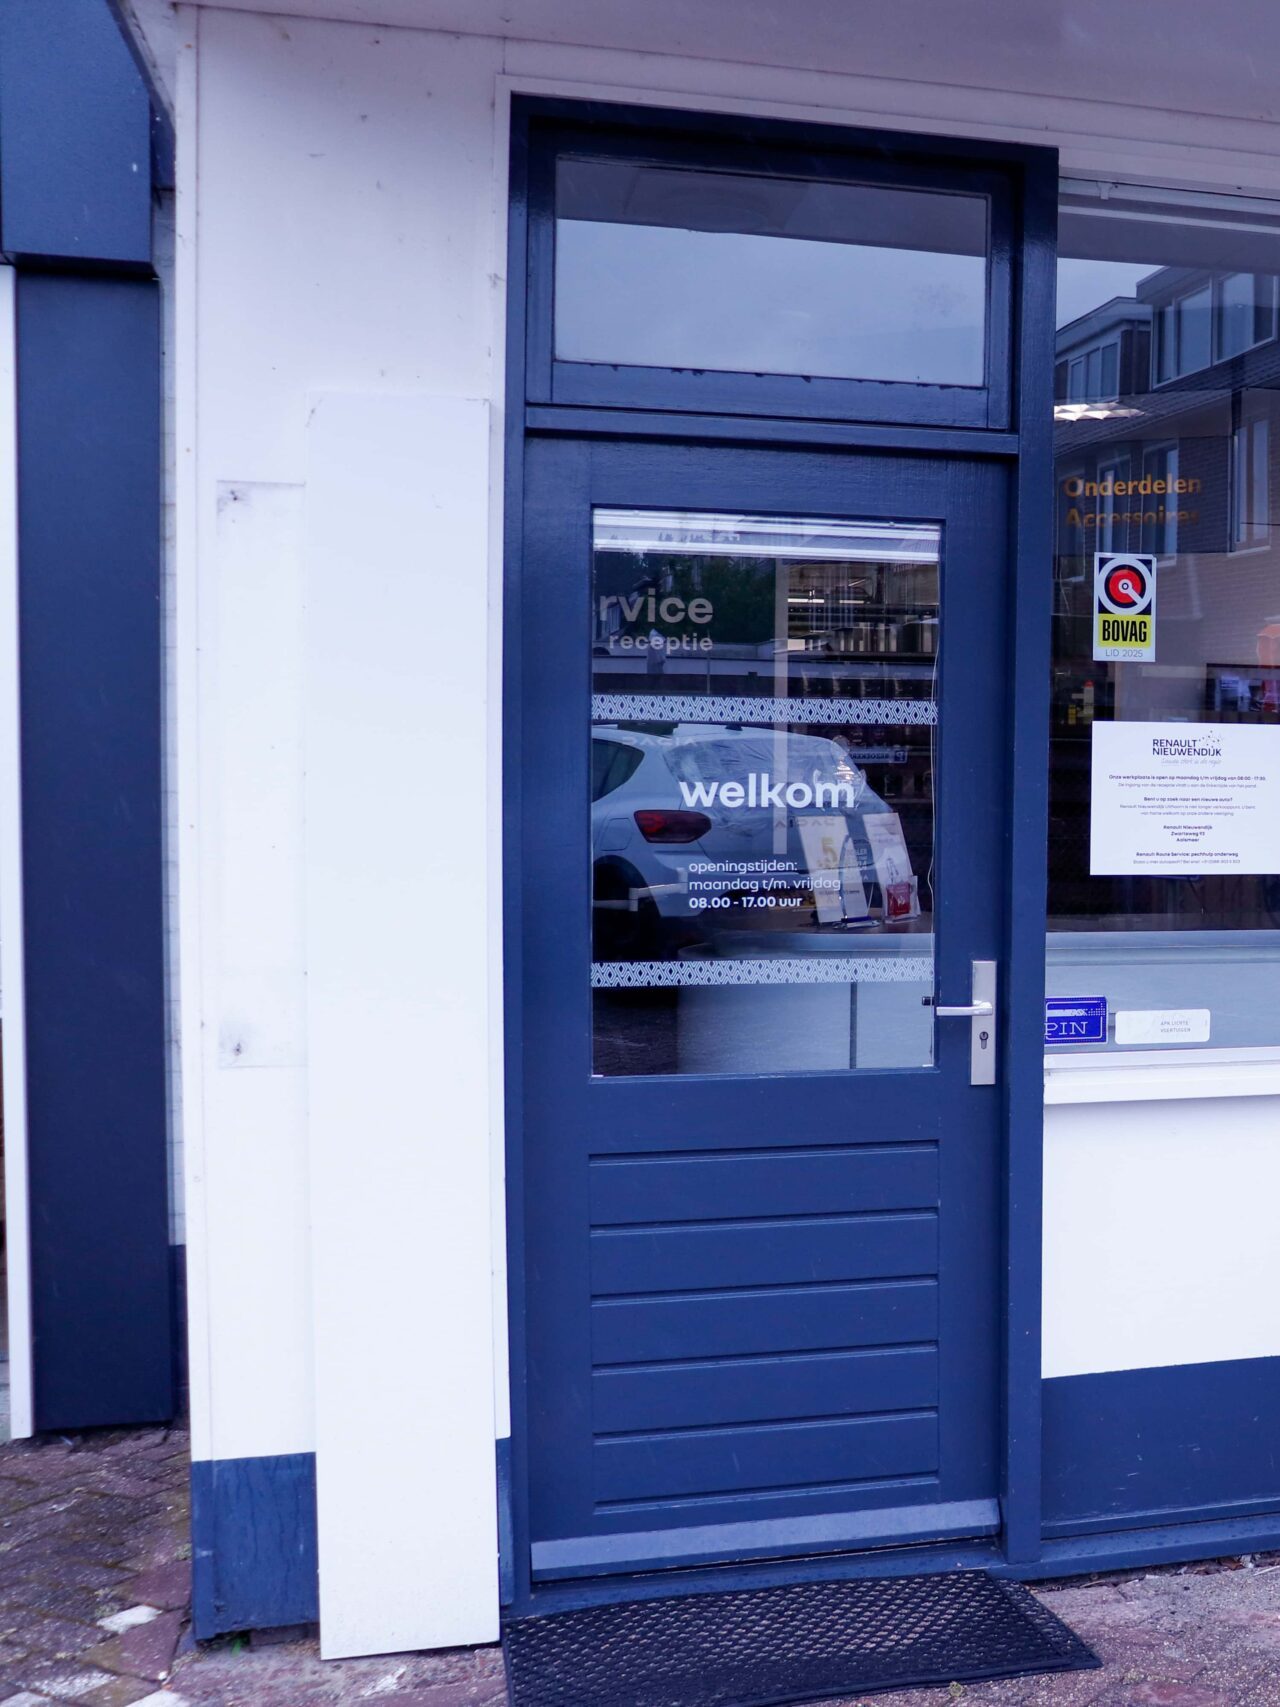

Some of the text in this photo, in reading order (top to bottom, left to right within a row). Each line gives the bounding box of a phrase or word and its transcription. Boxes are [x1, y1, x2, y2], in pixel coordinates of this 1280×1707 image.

[1064, 474, 1200, 497] Onderdelen
[1066, 506, 1200, 528] Accessoires
[1102, 619, 1147, 643] BOVAG
[609, 633, 713, 654] receptie
[1105, 648, 1143, 658] LID 2025
[1152, 738, 1197, 748] RENAULT
[1152, 748, 1222, 756] NIEUWENDIJK
[679, 773, 855, 808] welkom
[689, 860, 798, 875] openingstijden:
[689, 878, 841, 892] maandag t/m. vrijdag
[689, 897, 730, 908] 08.00
[742, 897, 778, 908] 17.00
[780, 898, 802, 908] uur
[1044, 1022, 1088, 1036] PIN
